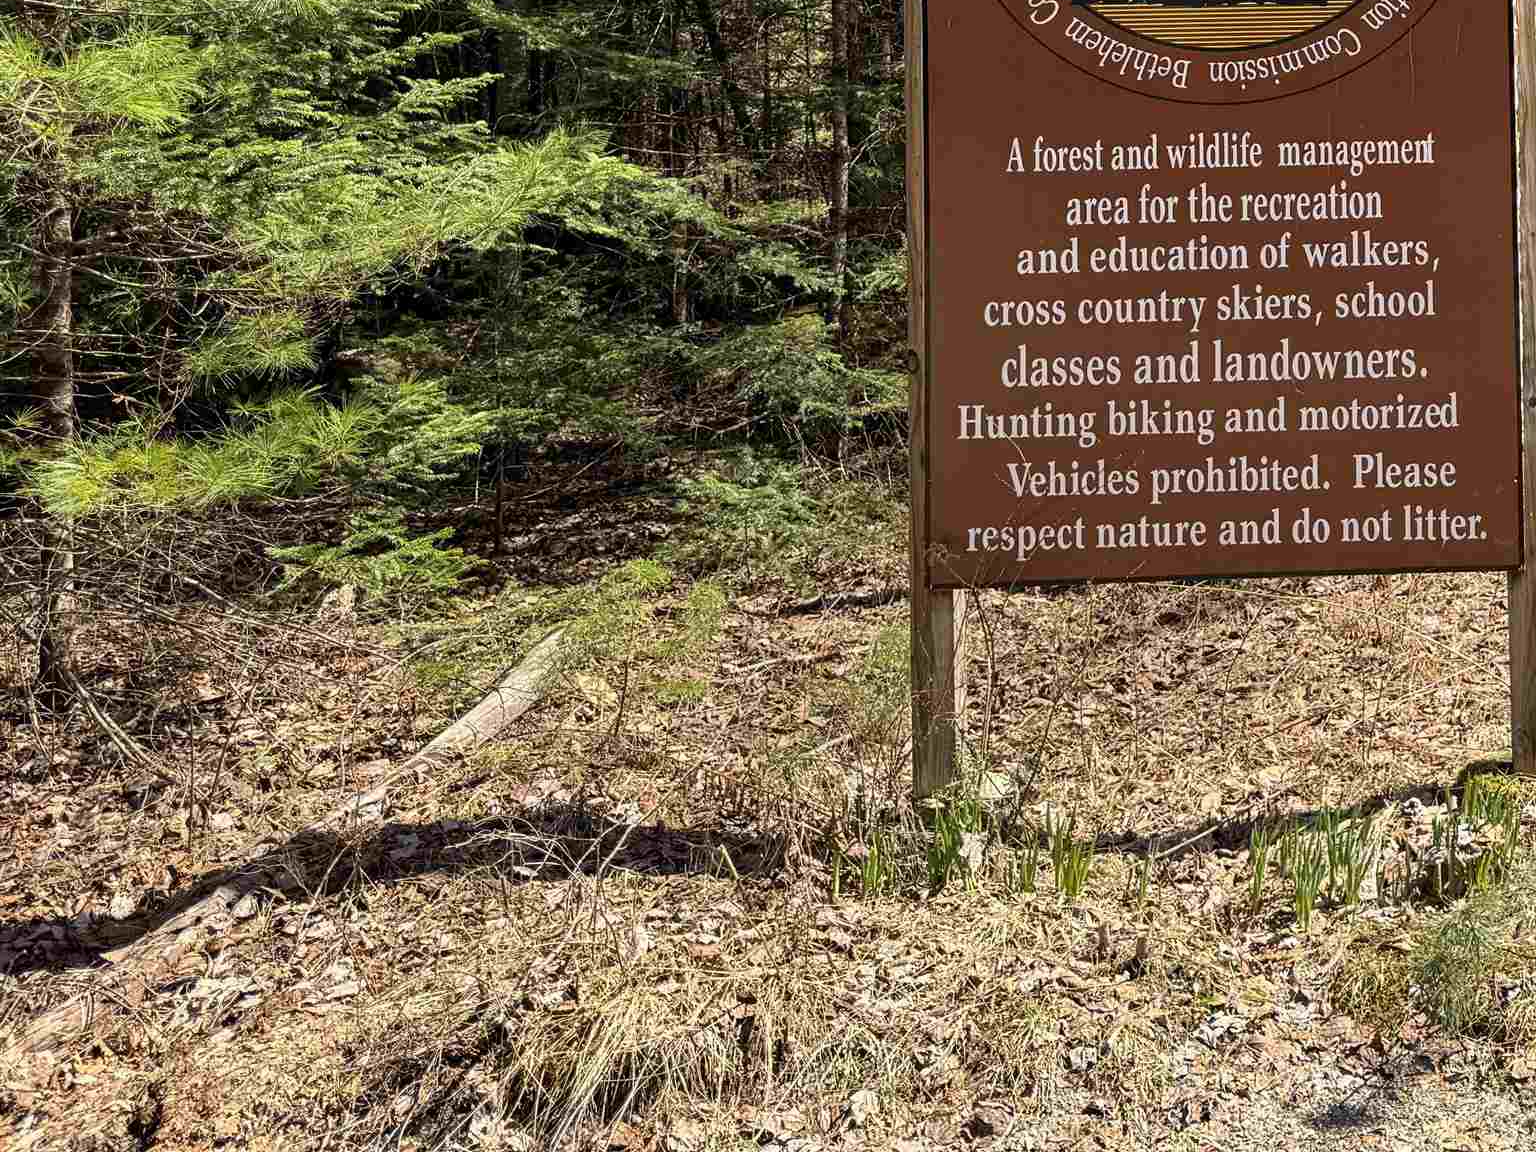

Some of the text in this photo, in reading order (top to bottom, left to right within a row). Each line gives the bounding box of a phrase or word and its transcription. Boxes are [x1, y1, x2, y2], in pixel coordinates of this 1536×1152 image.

[1064, 16, 1193, 90] Bethlehem
[1207, 26, 1362, 91] Commission
[1005, 130, 1435, 177] A forest and wildlife management
[1066, 179, 1384, 226] area for the recreation
[1016, 229, 1440, 275] and education of walkers,
[984, 279, 1436, 333] cross country skiers, school
[1001, 337, 1428, 388] classes and landowners.
[957, 391, 1460, 449] Hunting biking and motorized
[1006, 451, 1457, 505] Vehicles prohibited. Please
[966, 504, 1488, 562] respect nature and do not litter.
